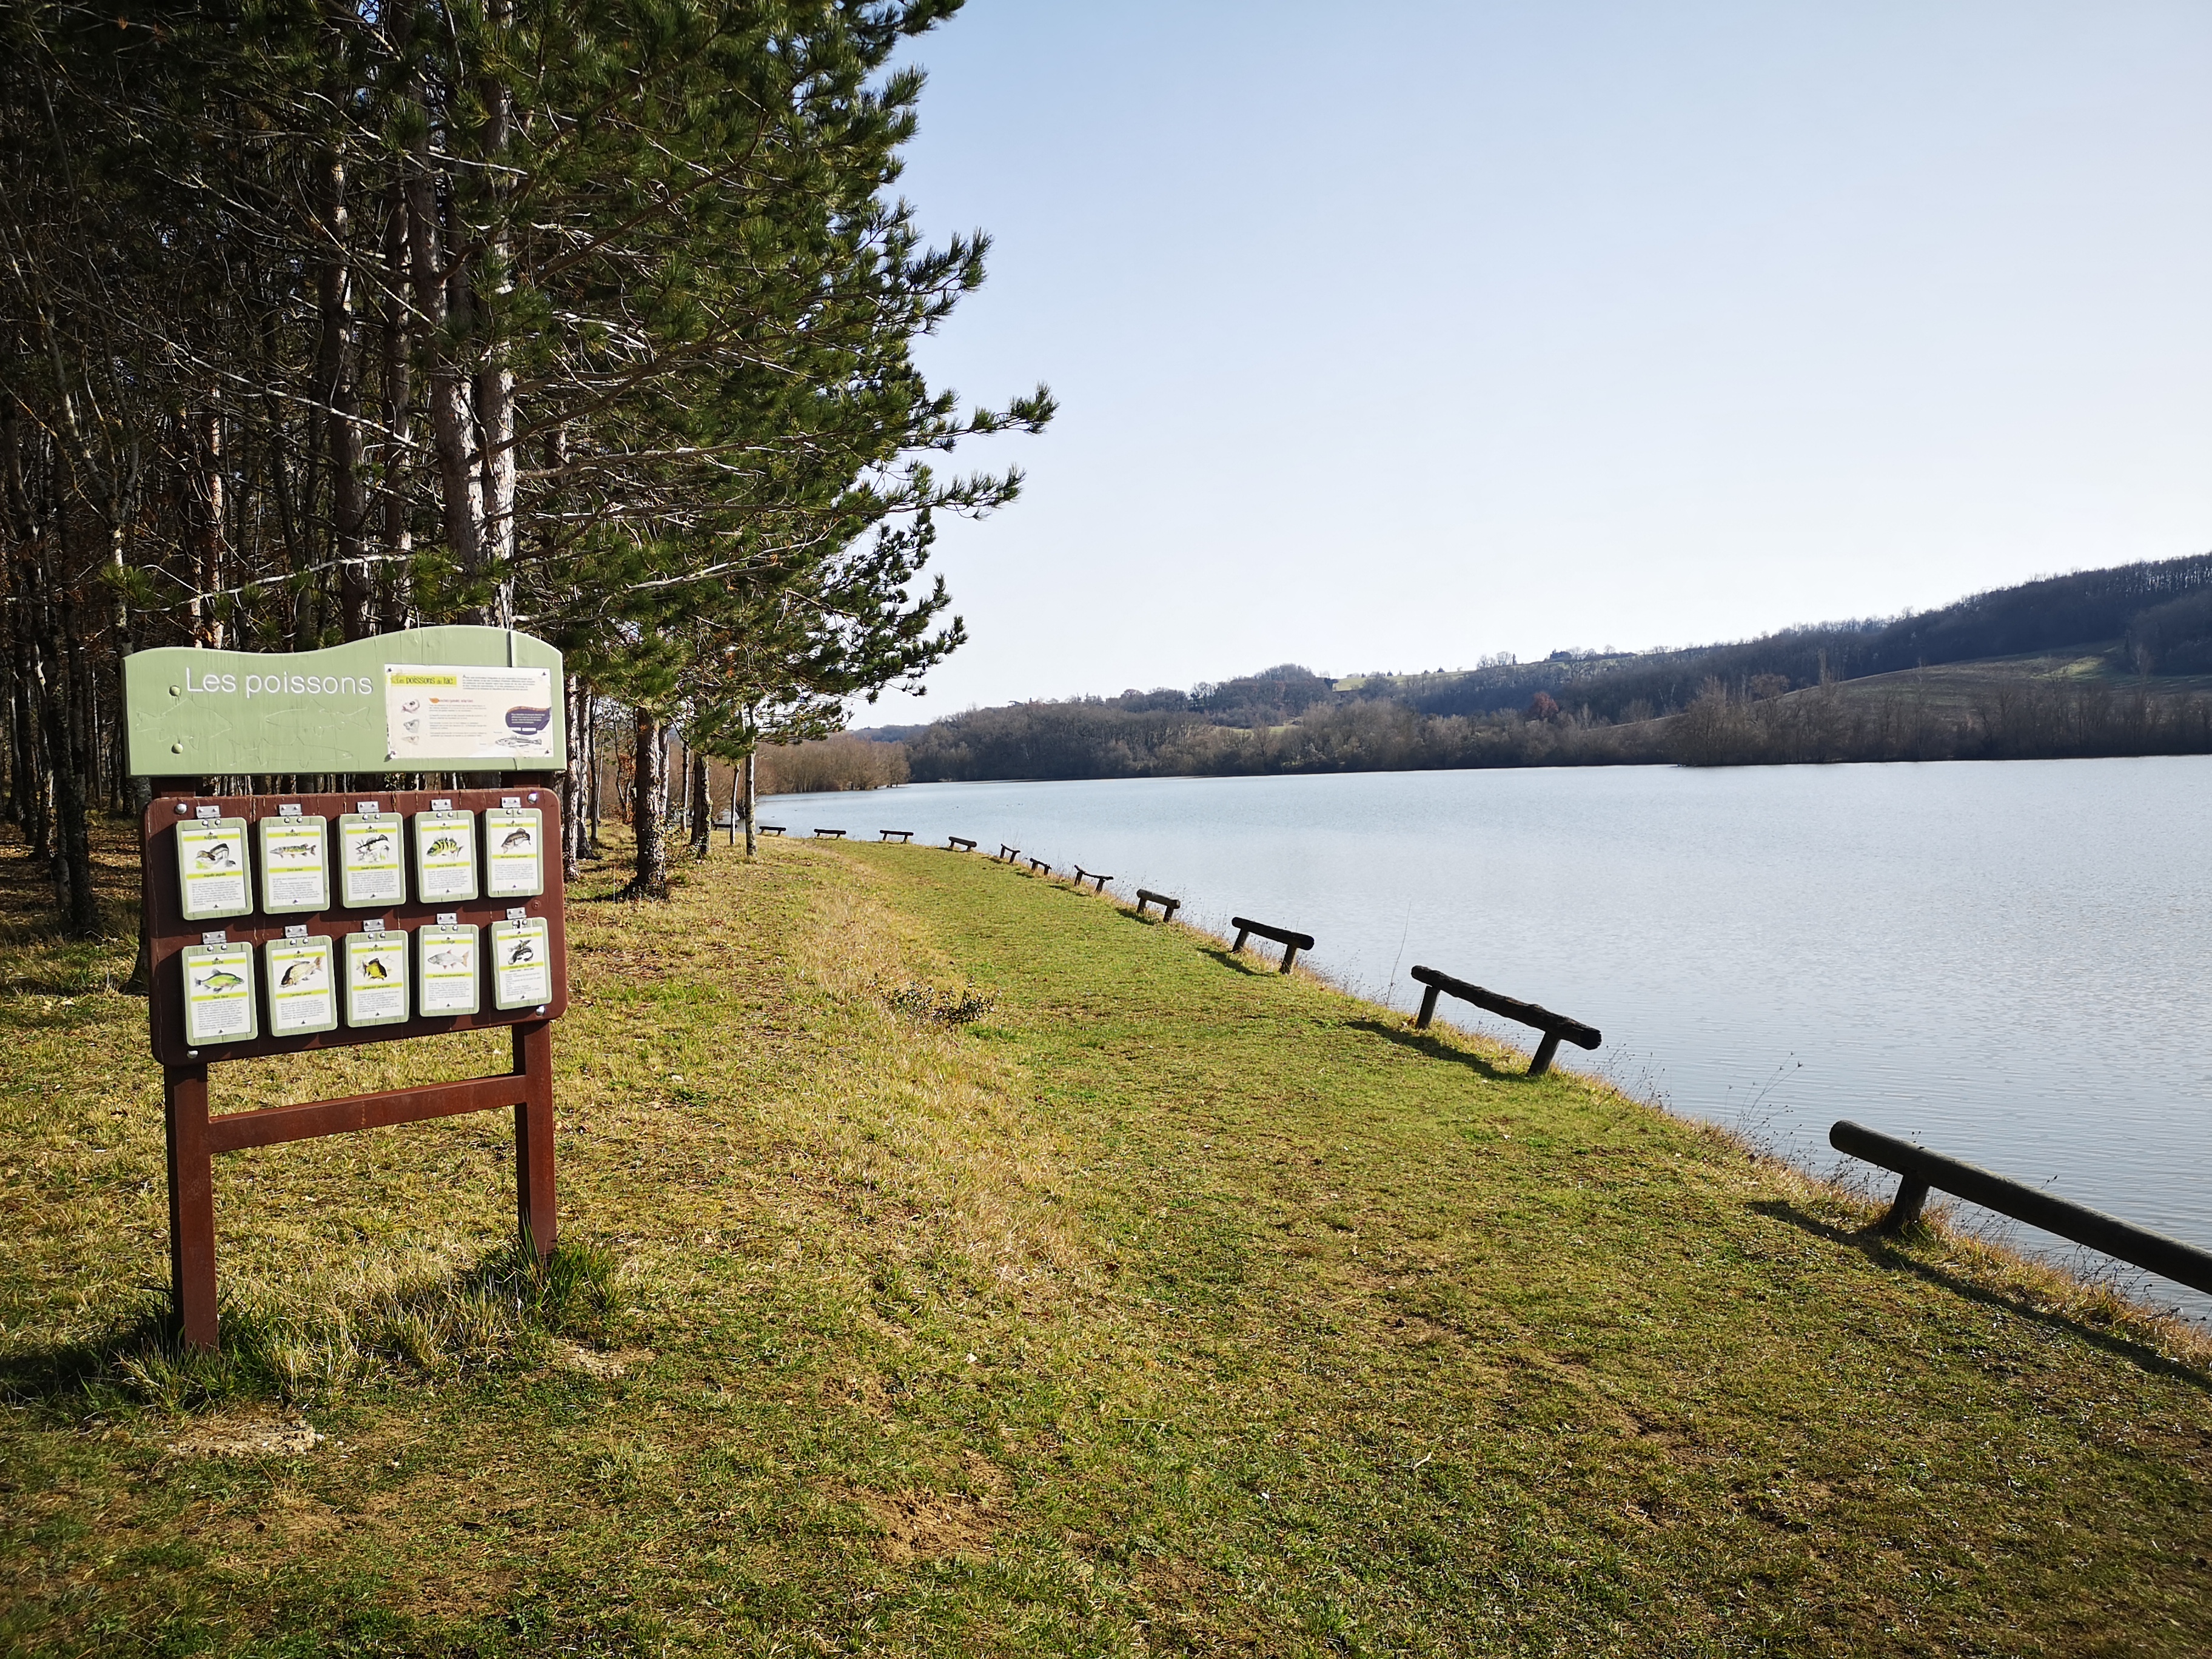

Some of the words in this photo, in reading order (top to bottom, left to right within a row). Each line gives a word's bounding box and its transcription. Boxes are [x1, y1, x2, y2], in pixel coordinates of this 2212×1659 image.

[186, 667, 236, 692] Les
[246, 671, 374, 699] poissons
[406, 676, 435, 685] poissons
